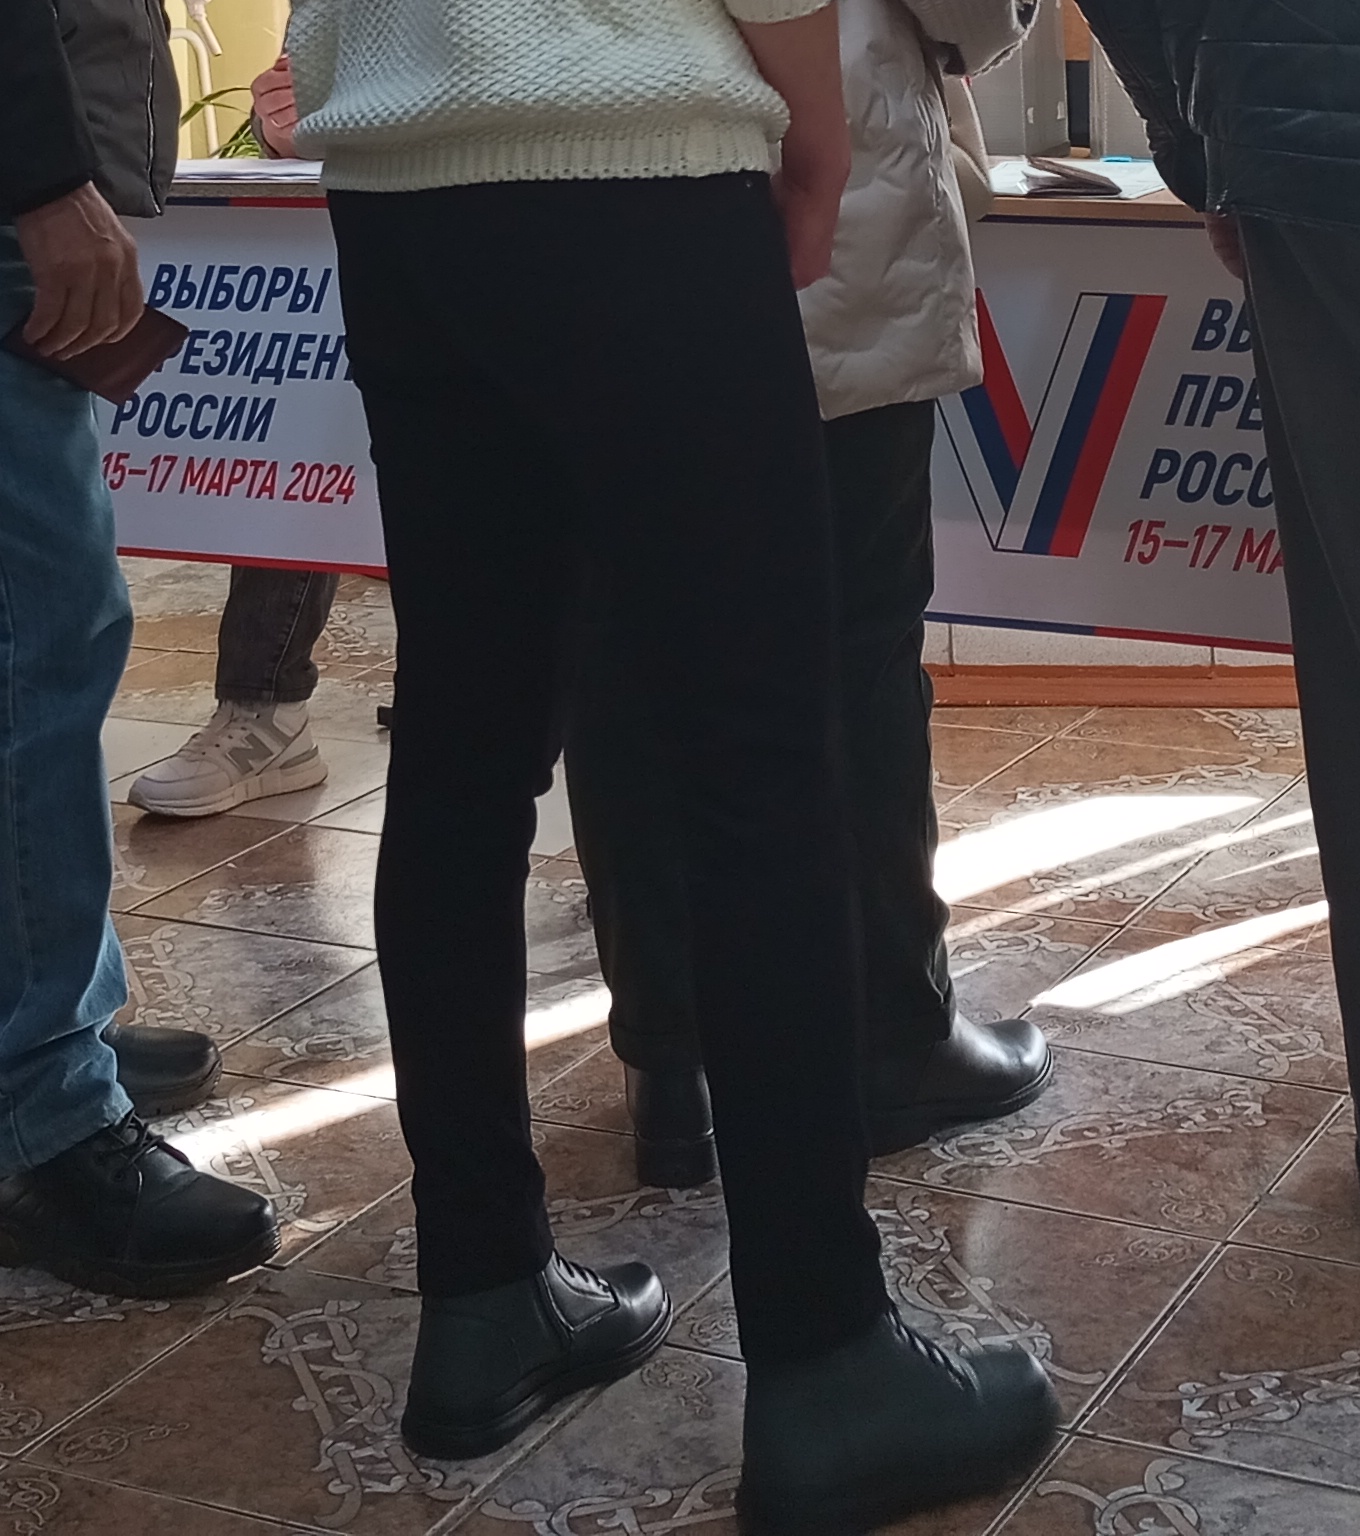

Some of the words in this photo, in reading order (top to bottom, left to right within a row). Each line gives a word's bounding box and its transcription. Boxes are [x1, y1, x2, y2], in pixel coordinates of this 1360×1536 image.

[147, 263, 332, 314] ВЫБОРЫ
[110, 391, 277, 443] РОССИИ
[179, 456, 279, 500] МАРТА
[283, 461, 356, 505] 2024
